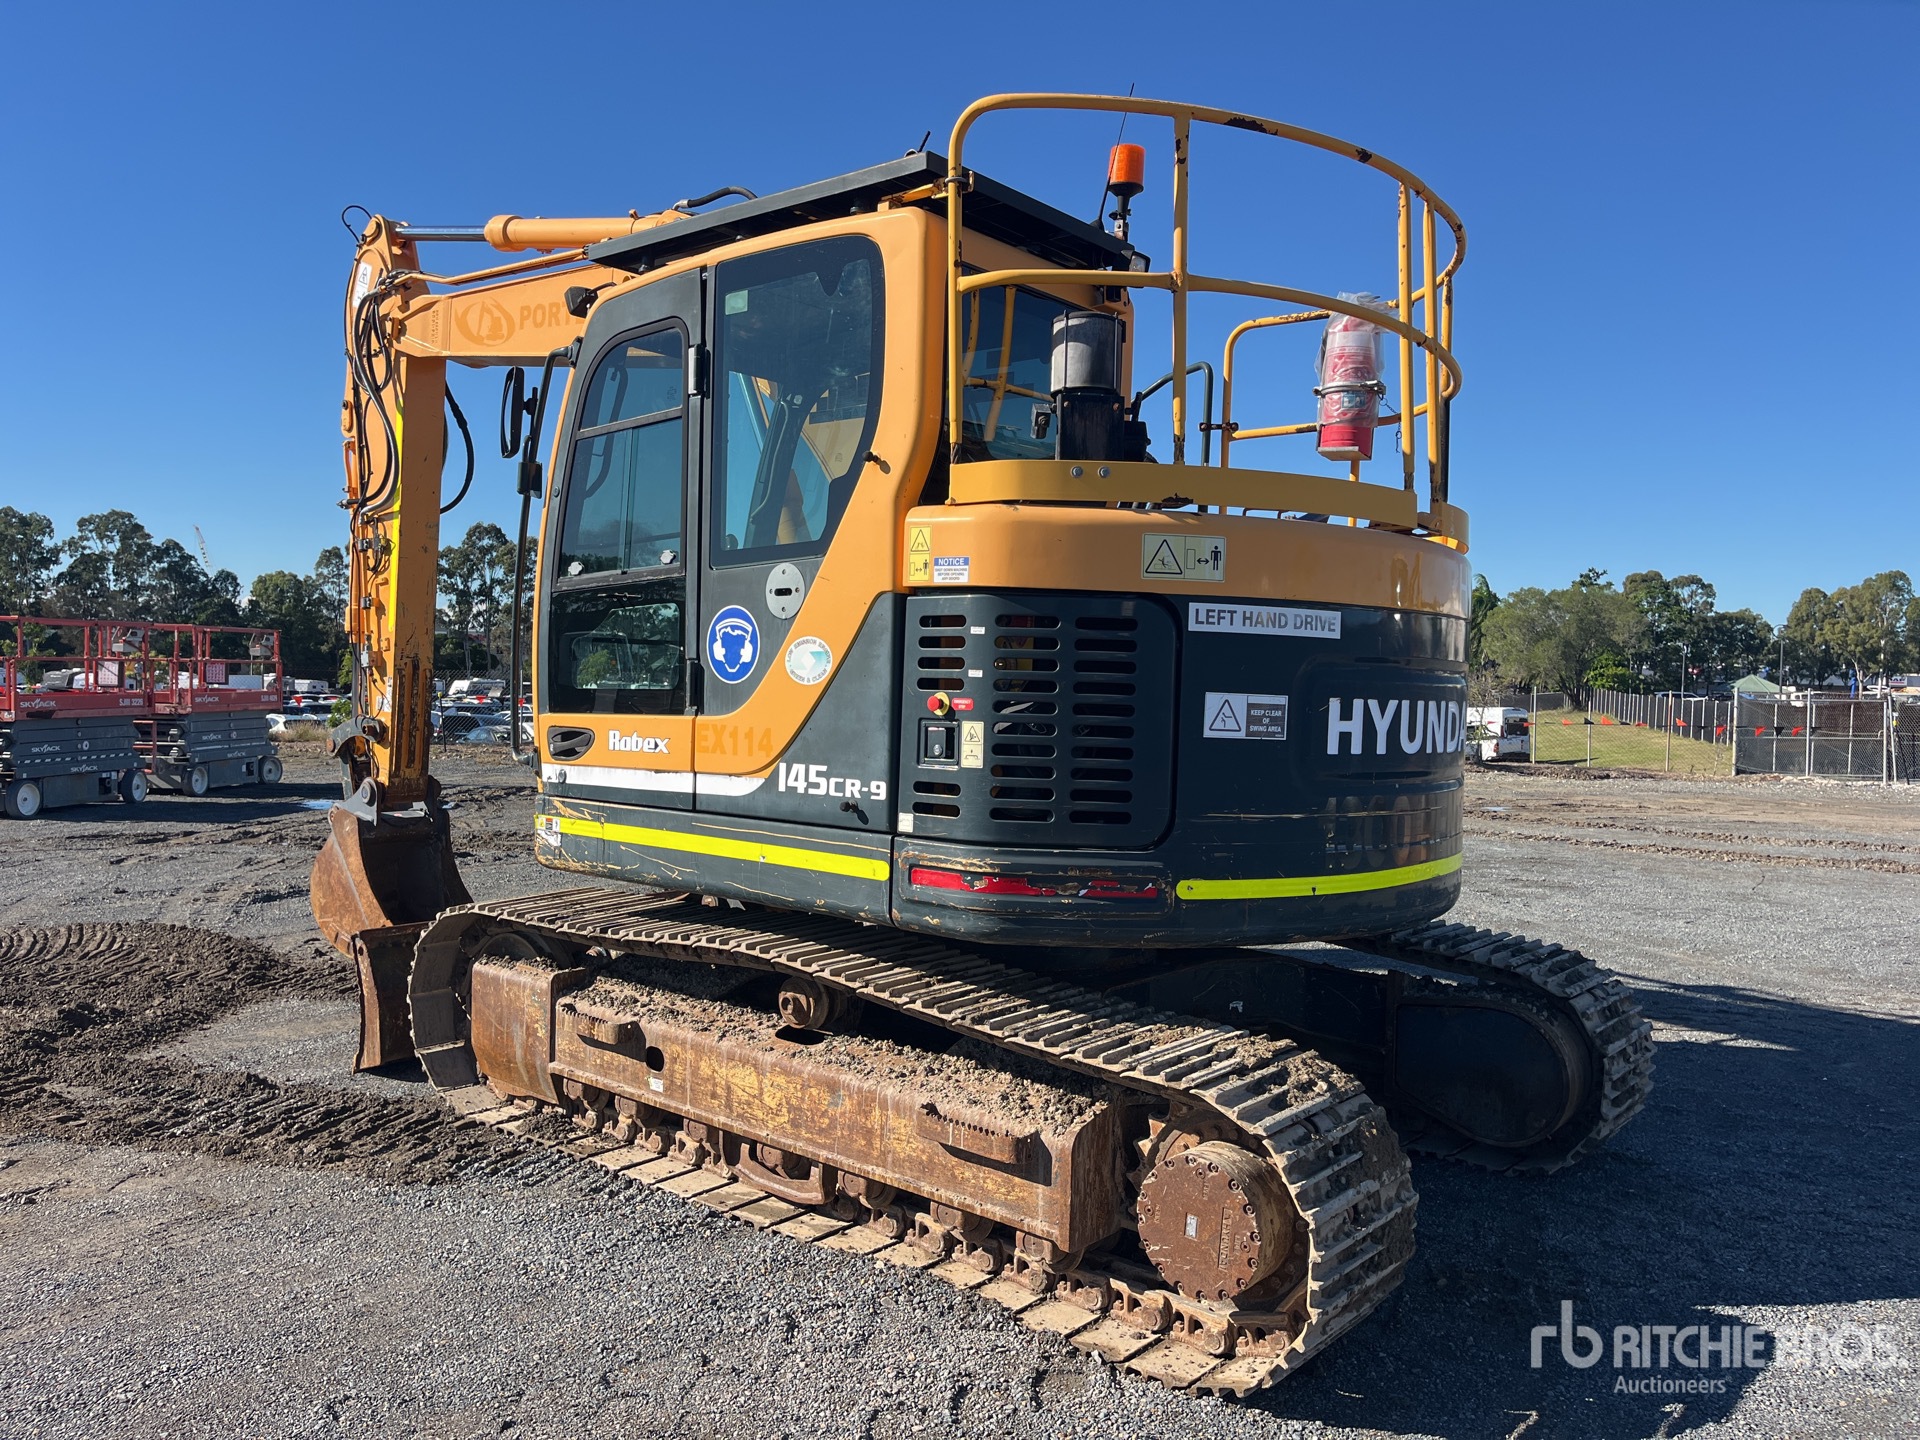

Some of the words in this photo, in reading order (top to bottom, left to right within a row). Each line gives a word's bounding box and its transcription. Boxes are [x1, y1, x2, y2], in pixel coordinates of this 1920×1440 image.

[938, 558, 965, 566] NOTICE
[1195, 608, 1237, 626] LEFT
[1242, 610, 1288, 629] HAND
[1294, 613, 1336, 632] DRIVE
[194, 694, 219, 703] SKYJACK
[20, 698, 56, 709] SKYJACK
[1327, 697, 1467, 755] HYUNDA
[202, 733, 222, 741] SKYJACK
[608, 729, 671, 754] Robex
[696, 723, 774, 758] EX114
[31, 744, 61, 753] SKYJACK
[227, 750, 246, 758] SKYJACK
[70, 764, 98, 773] SKYJACK
